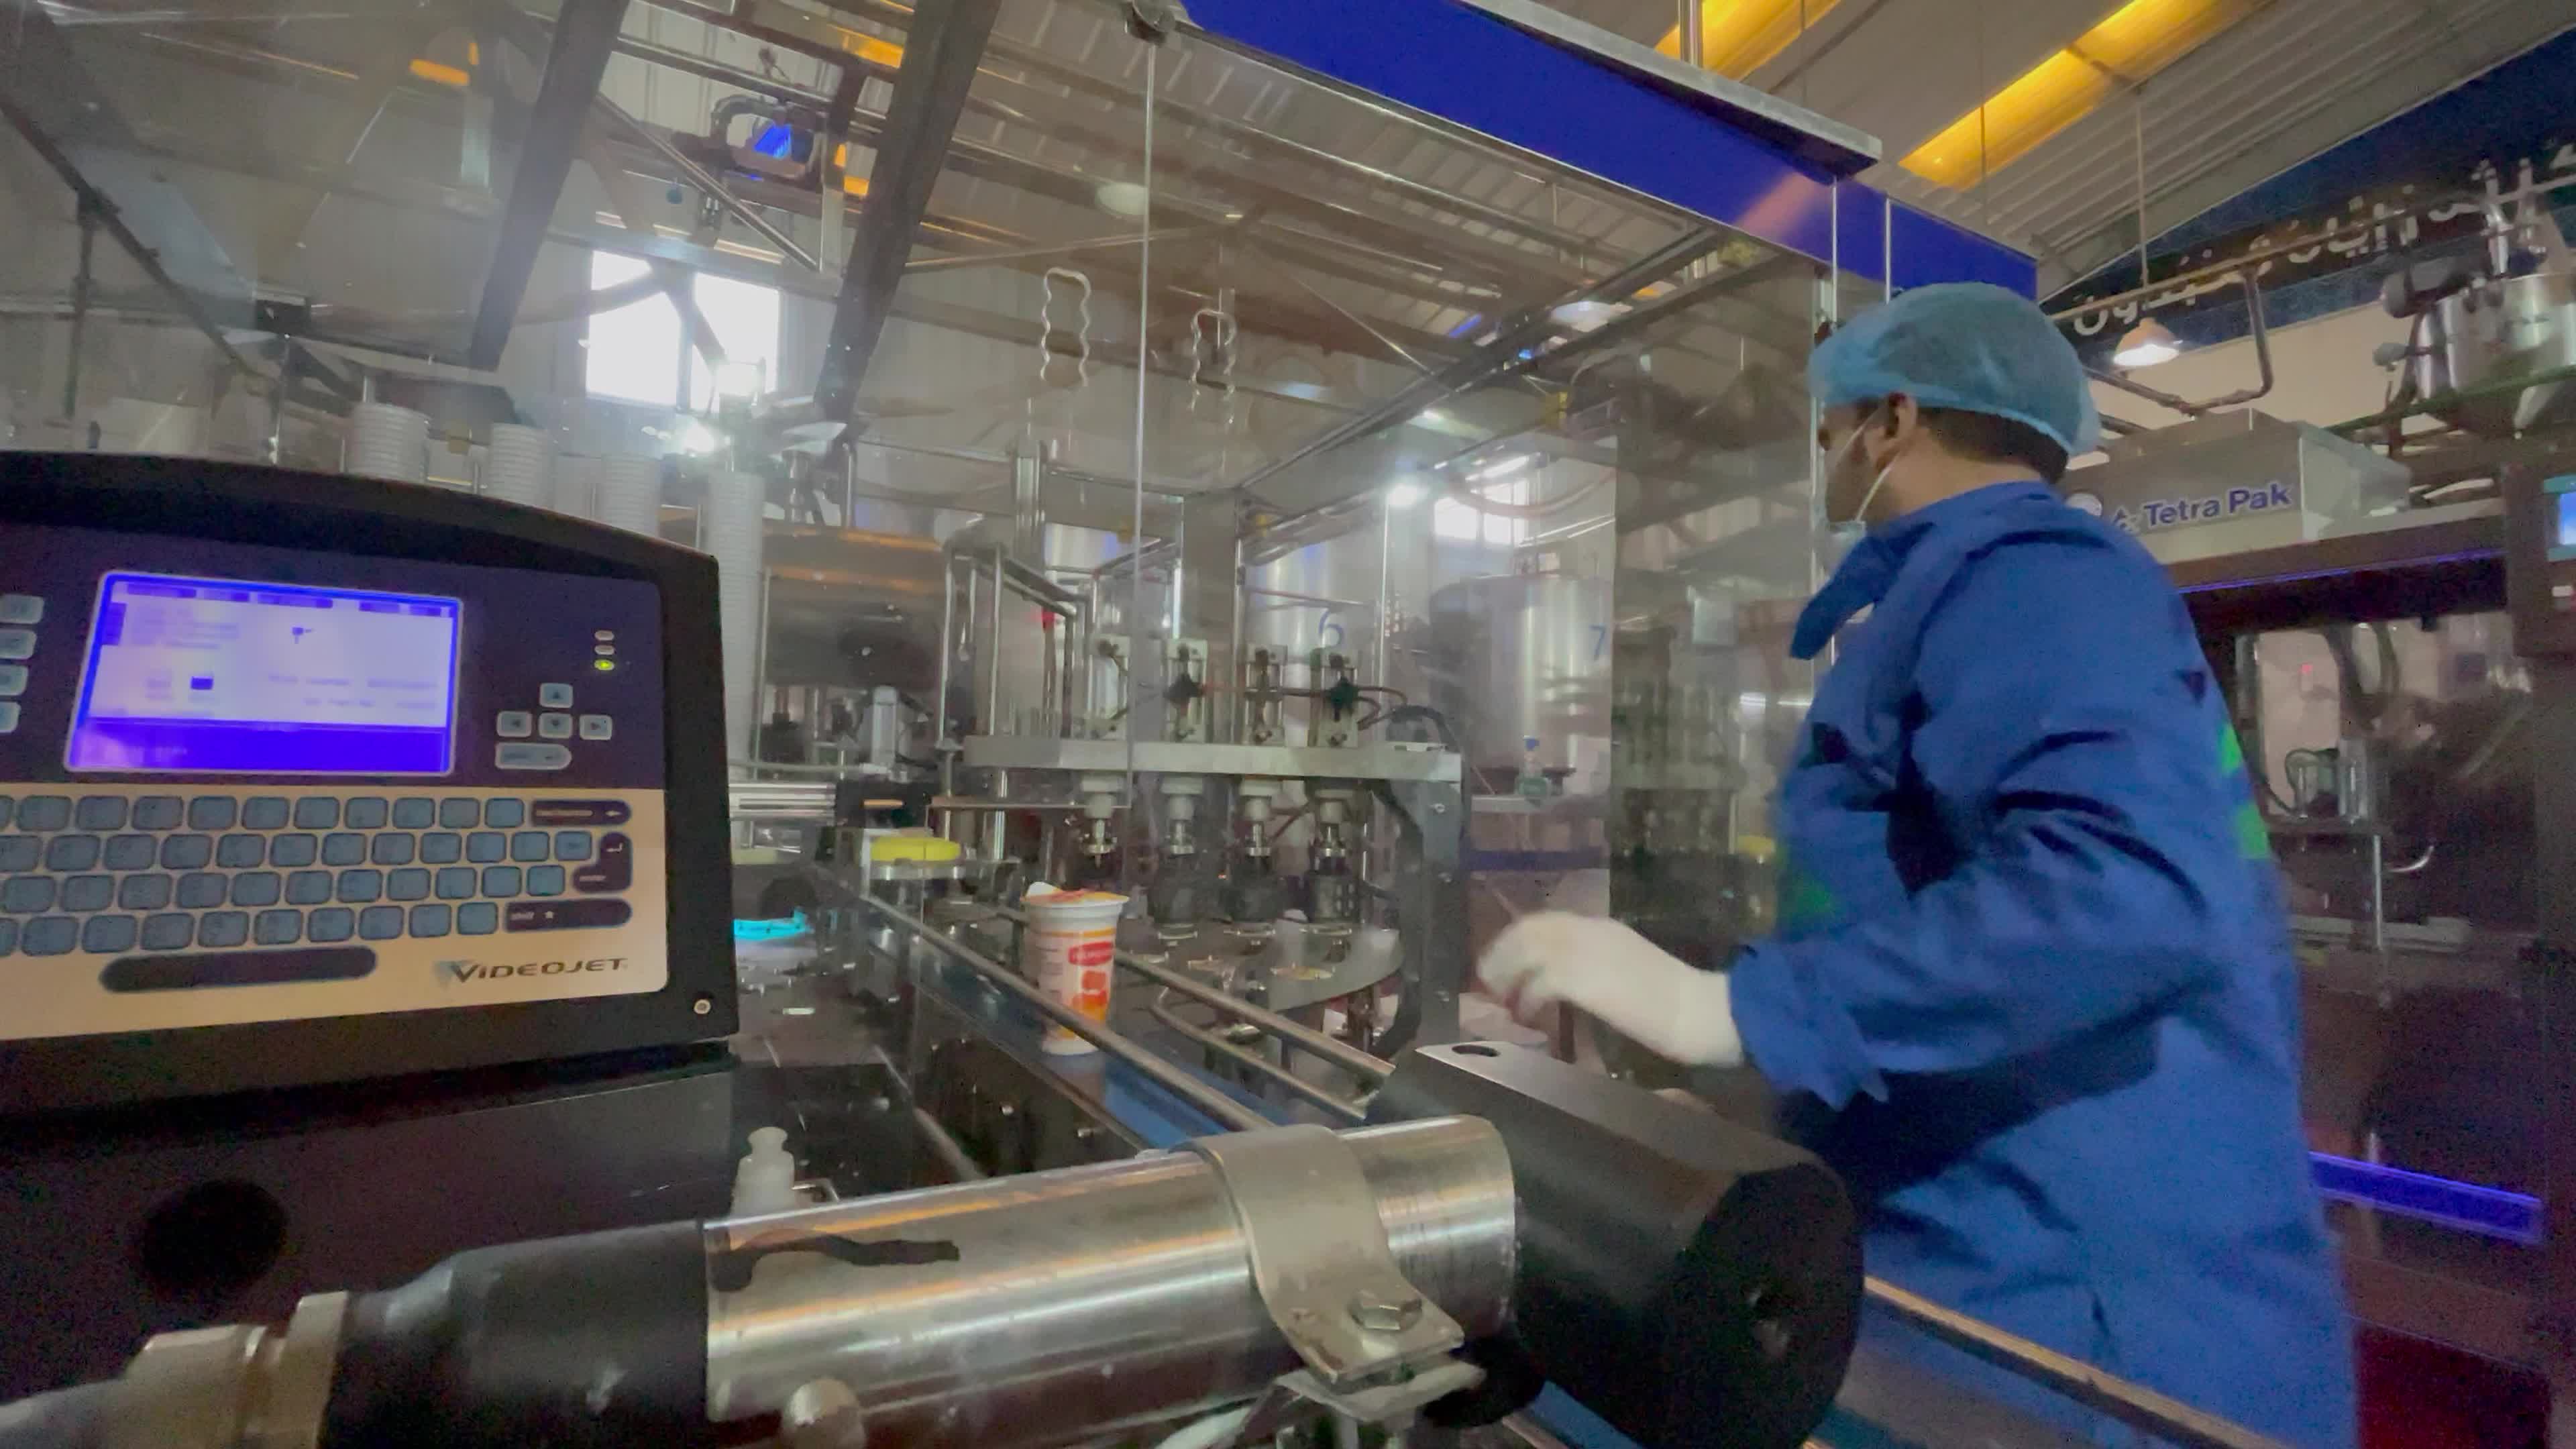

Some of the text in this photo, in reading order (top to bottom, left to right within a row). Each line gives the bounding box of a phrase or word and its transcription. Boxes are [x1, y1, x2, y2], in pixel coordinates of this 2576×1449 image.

[2143, 482, 2292, 527] Tetra Pak
[1589, 624, 1607, 660] 7
[448, 957, 629, 984] VIDEOJET
